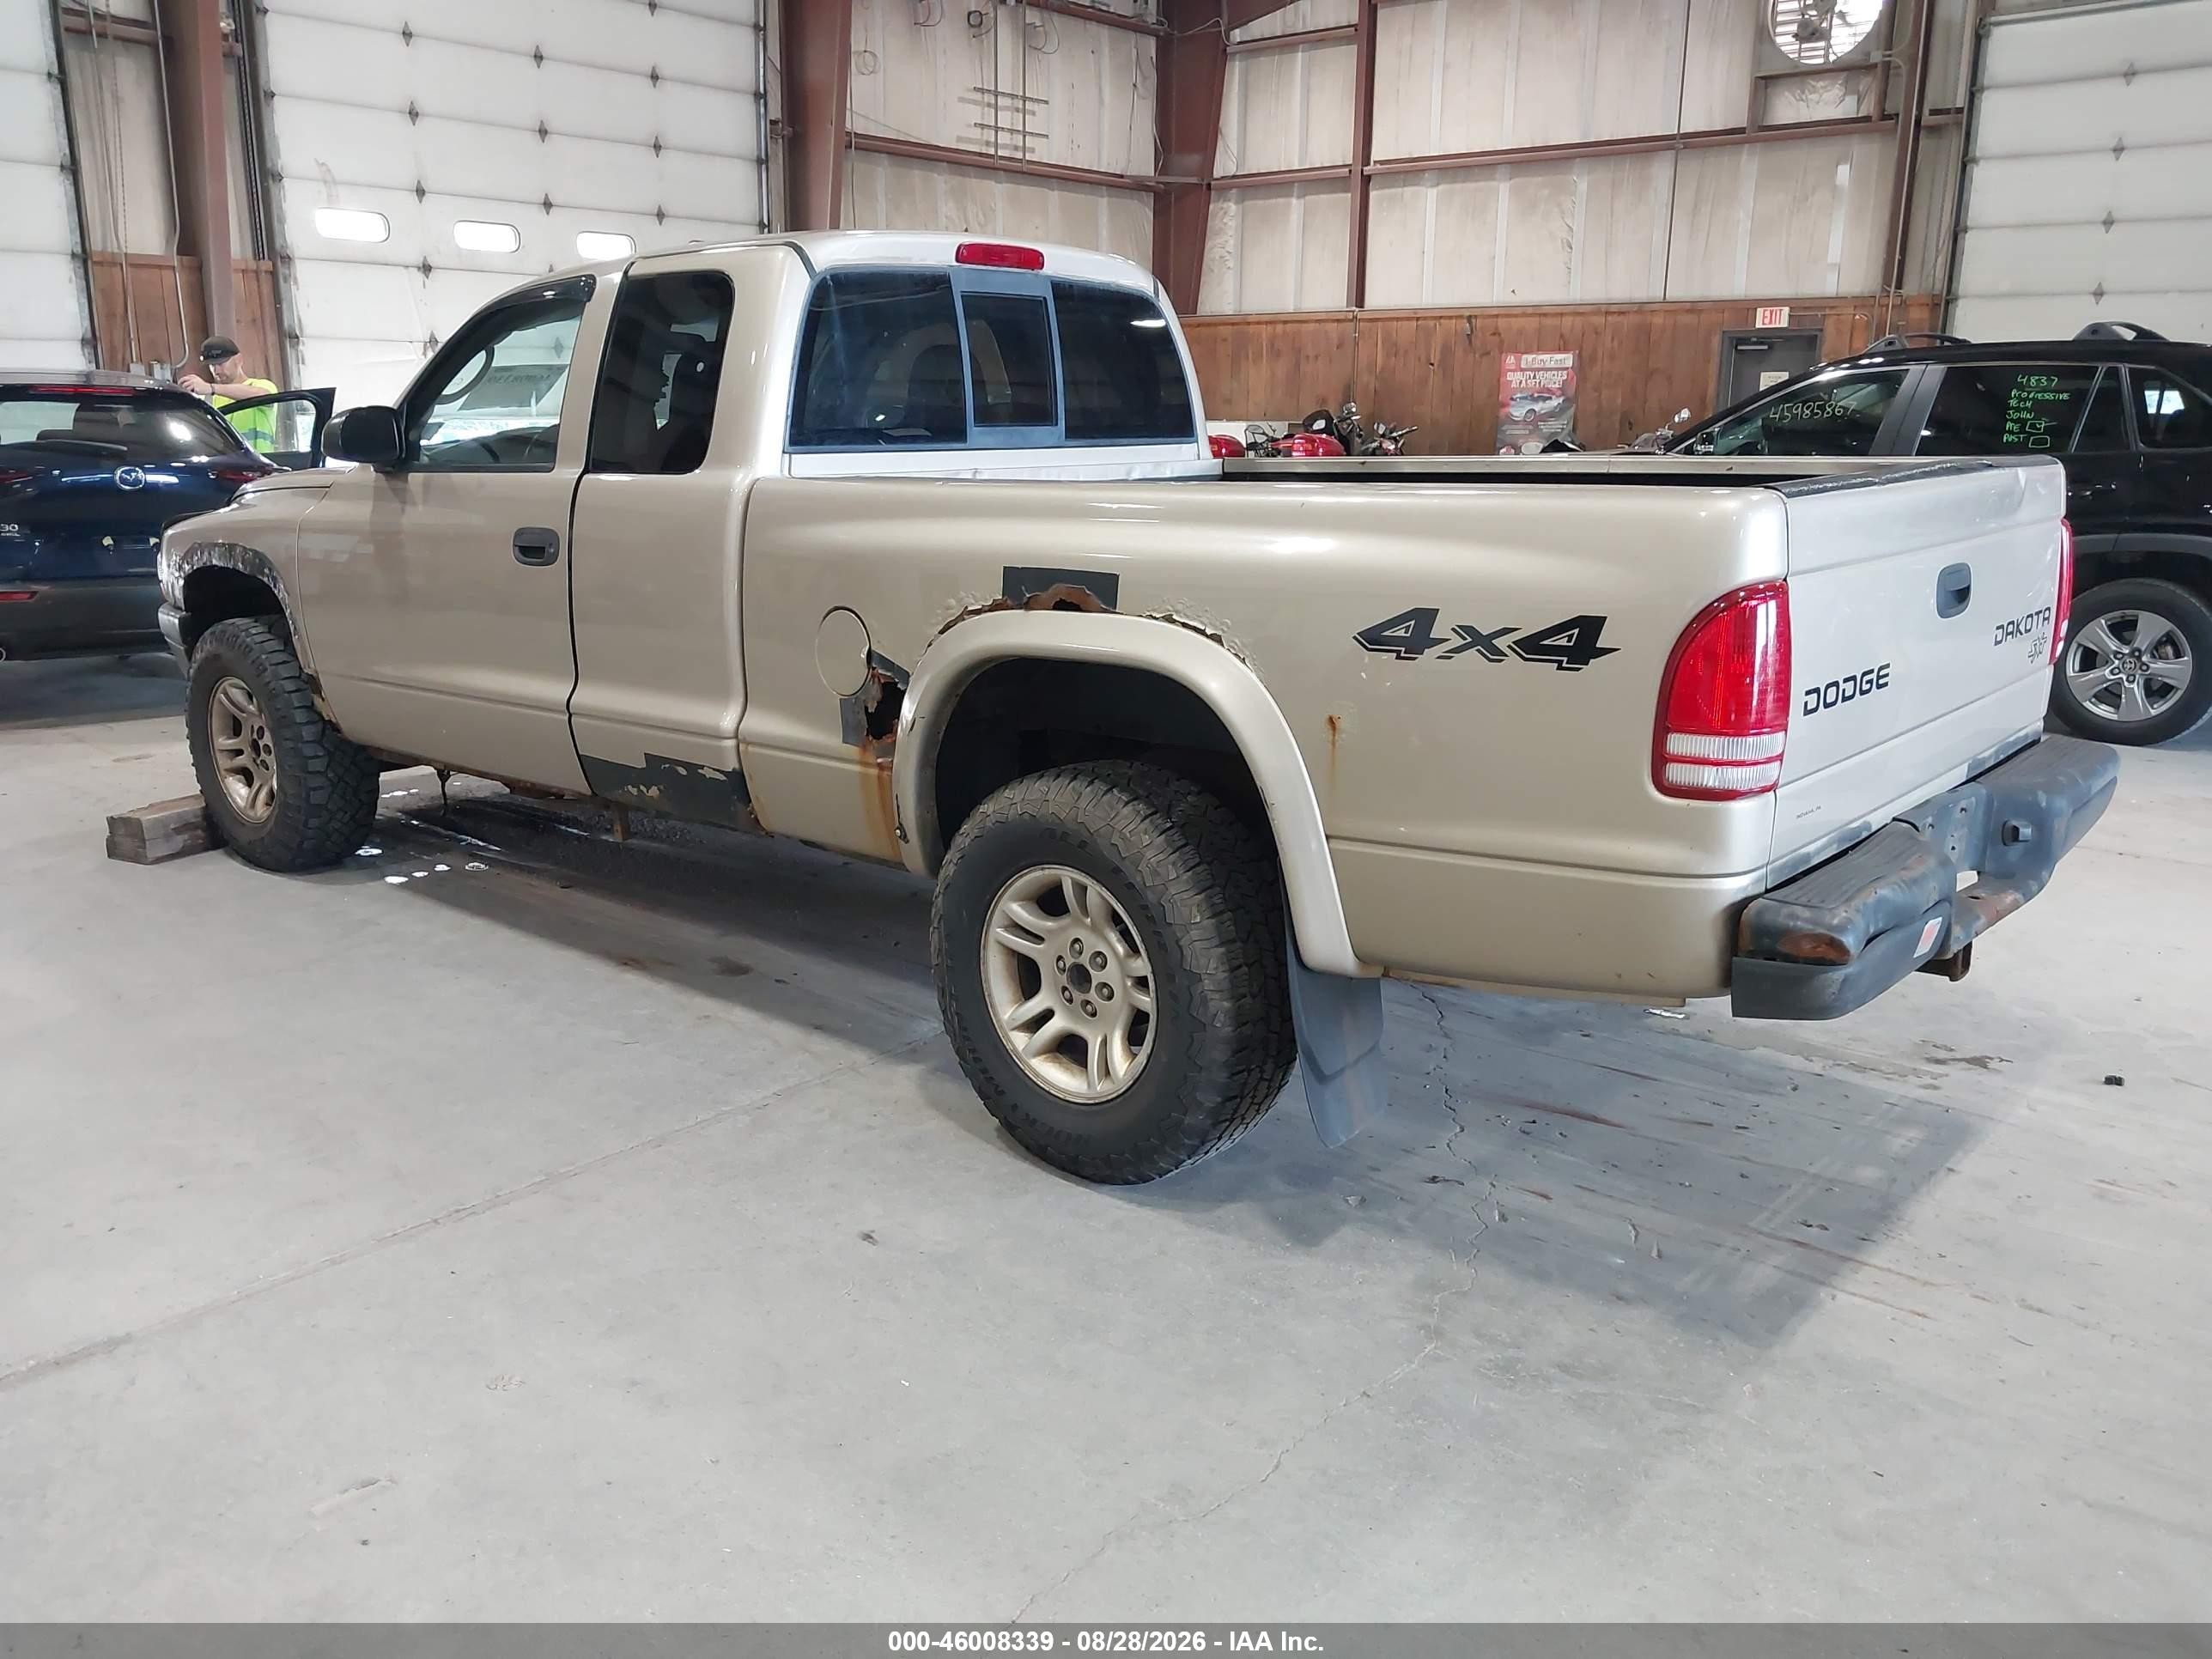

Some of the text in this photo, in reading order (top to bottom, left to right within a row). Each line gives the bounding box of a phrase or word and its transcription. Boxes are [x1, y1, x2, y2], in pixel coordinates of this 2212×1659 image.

[1762, 308, 1784, 325] EXIT
[1506, 370, 1567, 380] QUALITY VEHICLES
[2017, 374, 2058, 387] 4837
[1769, 401, 1857, 422] 45985867
[2005, 410, 2034, 419] JOHN
[1994, 606, 2051, 646] DAKOTA
[1803, 662, 1891, 716] DODGE
